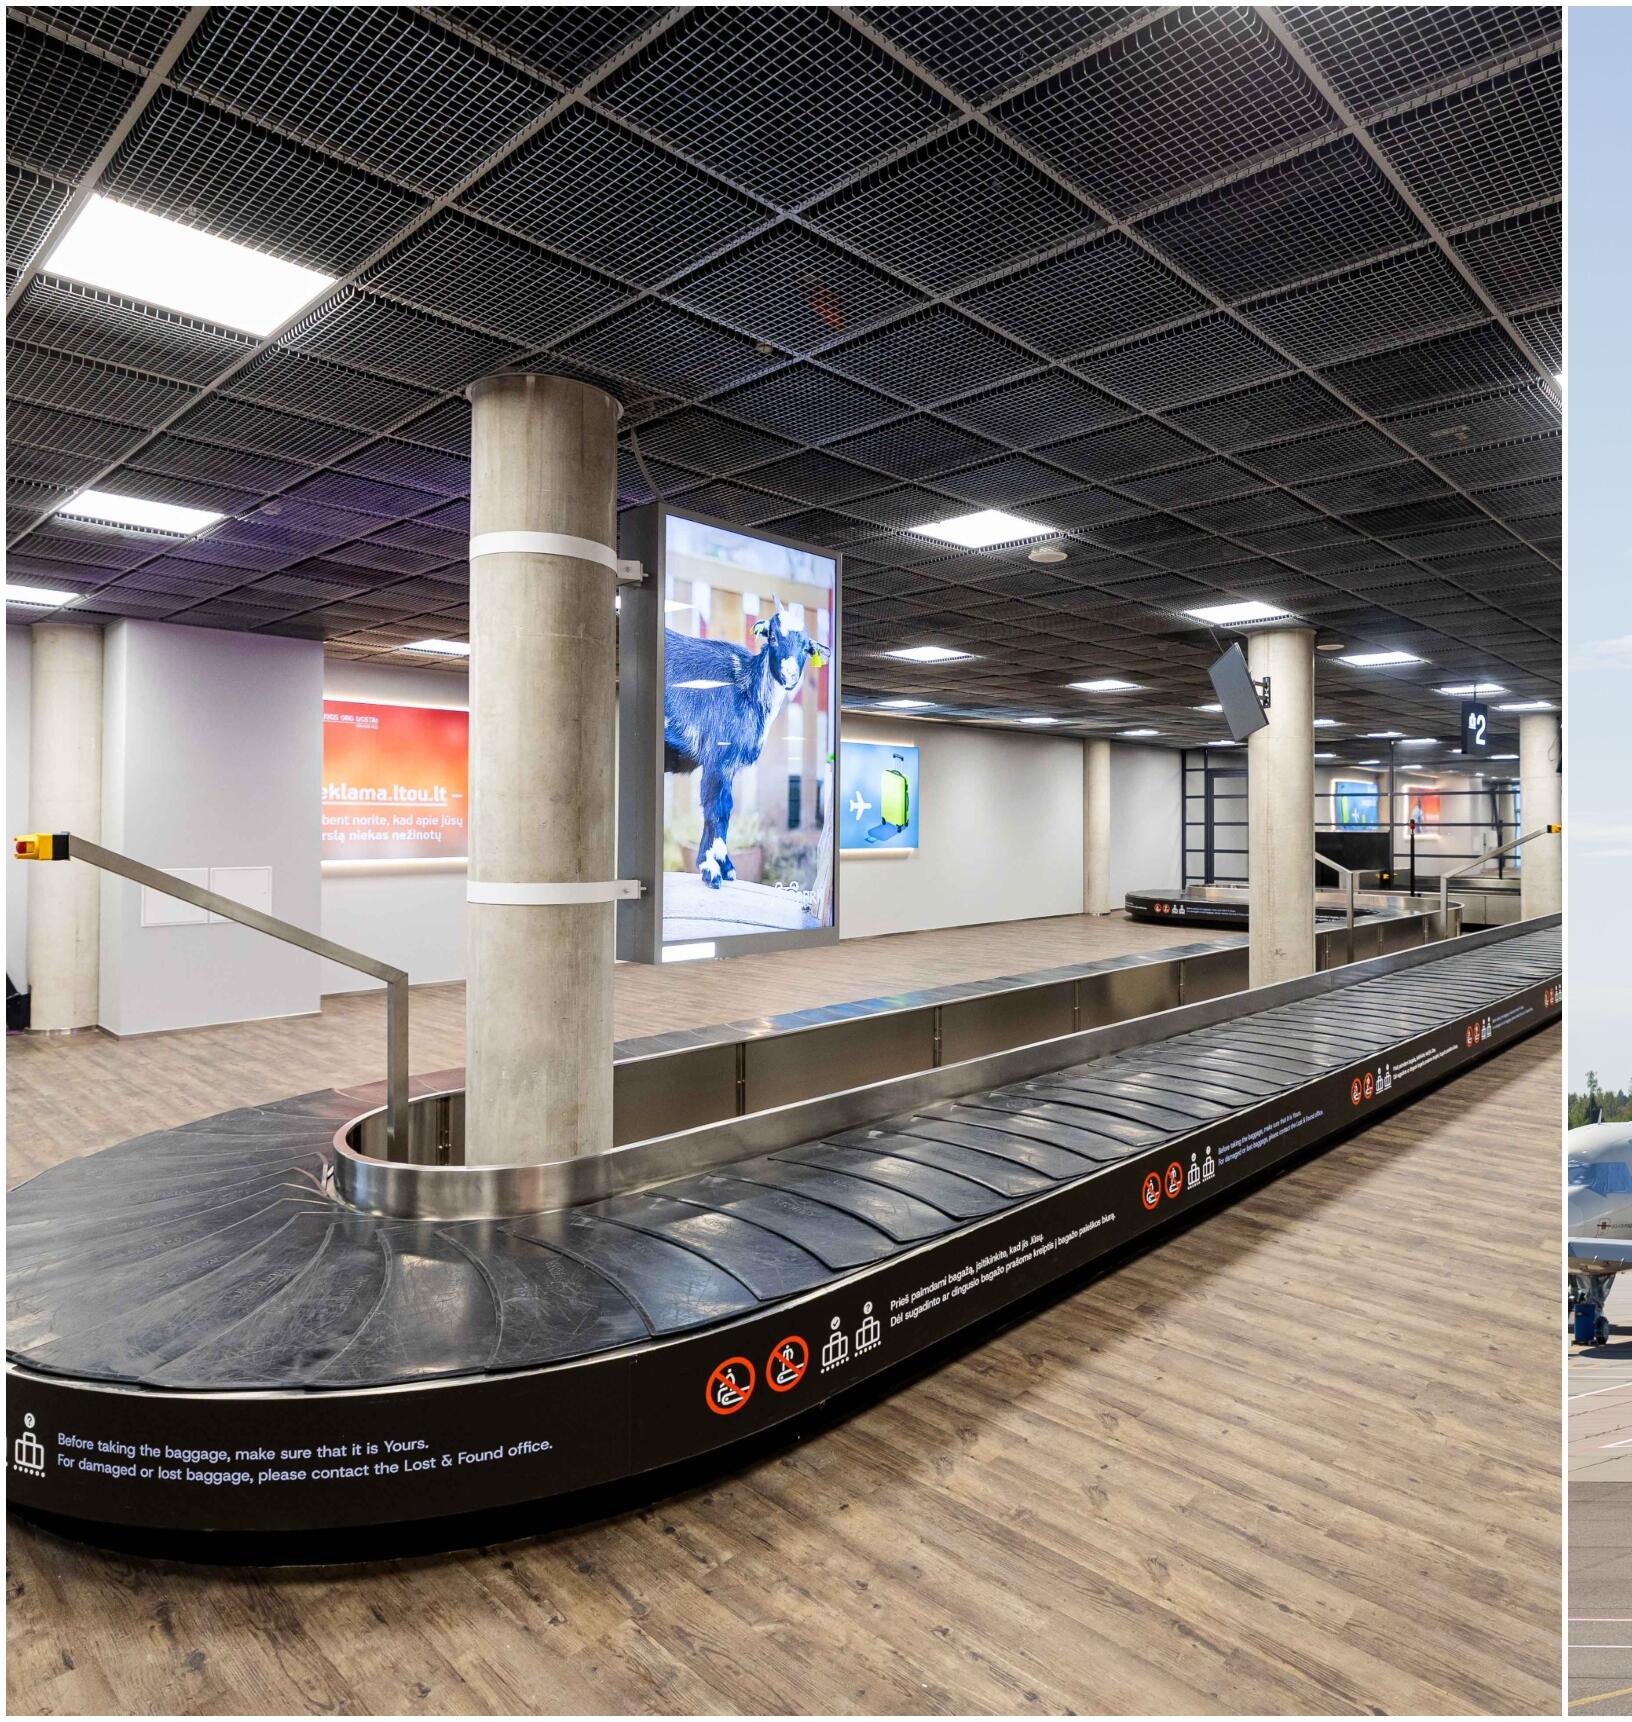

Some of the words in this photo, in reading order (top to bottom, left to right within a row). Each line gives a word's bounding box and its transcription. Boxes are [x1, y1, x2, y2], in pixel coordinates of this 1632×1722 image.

[1476, 714, 1486, 746] 2
[322, 814, 348, 826] bent
[352, 814, 390, 827] norite,
[392, 814, 414, 826] kad
[416, 815, 438, 828] apie
[440, 815, 464, 828] jūsų
[350, 830, 388, 841] niekas
[392, 829, 442, 842] nežinotų
[890, 1294, 910, 1311] Prieš
[911, 1276, 947, 1304] paimdami
[1009, 1242, 1021, 1255] kad
[890, 1312, 903, 1328] Dėl
[904, 1296, 940, 1320] sugadinto
[942, 1292, 950, 1302] ar
[951, 1278, 980, 1296] dingusio
[980, 1263, 1004, 1283] bagažo
[1006, 1252, 1032, 1274] prašome
[1033, 1240, 1054, 1258] kreiptis
[58, 1432, 95, 1450] Before
[98, 1440, 136, 1458] taking
[140, 1444, 161, 1458] the
[164, 1445, 232, 1463] baggage,
[235, 1447, 276, 1460] make
[280, 1448, 312, 1460] sure
[316, 1444, 348, 1458] that
[352, 1442, 362, 1456] it
[366, 1442, 378, 1455] is
[384, 1438, 430, 1453] Yours.
[58, 1454, 75, 1468] For
[78, 1458, 136, 1478] damaged
[140, 1467, 154, 1478] or
[158, 1466, 182, 1481] lost
[186, 1468, 254, 1485] baggage,
[258, 1468, 306, 1484] please
[311, 1464, 370, 1480] contact
[374, 1462, 399, 1475] the
[404, 1456, 436, 1472] Lost
[441, 1454, 453, 1468] &
[458, 1446, 503, 1465] Found
[508, 1438, 553, 1457] office.
